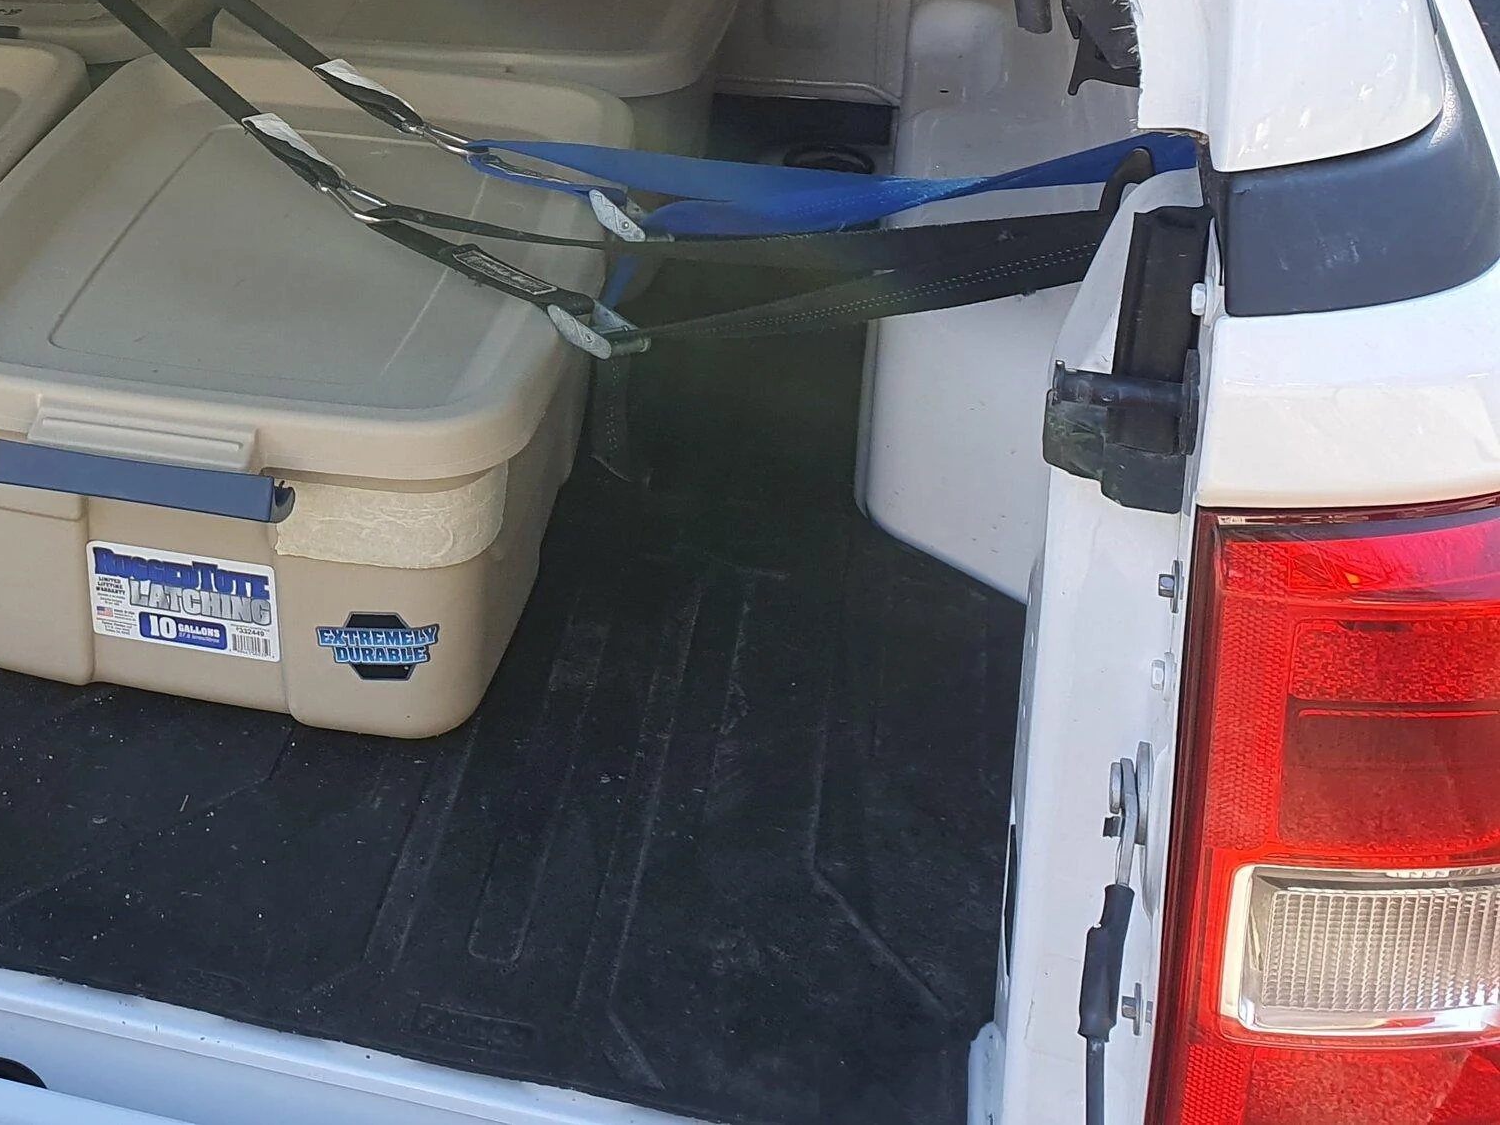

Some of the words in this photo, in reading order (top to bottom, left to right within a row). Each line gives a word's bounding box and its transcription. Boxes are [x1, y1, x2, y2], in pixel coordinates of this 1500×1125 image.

[128, 577, 273, 626] LATCHING
[148, 615, 178, 639] 10
[177, 623, 221, 638] GALLONS
[318, 625, 437, 648] EXTREMELY
[335, 645, 428, 665] DURABLE
